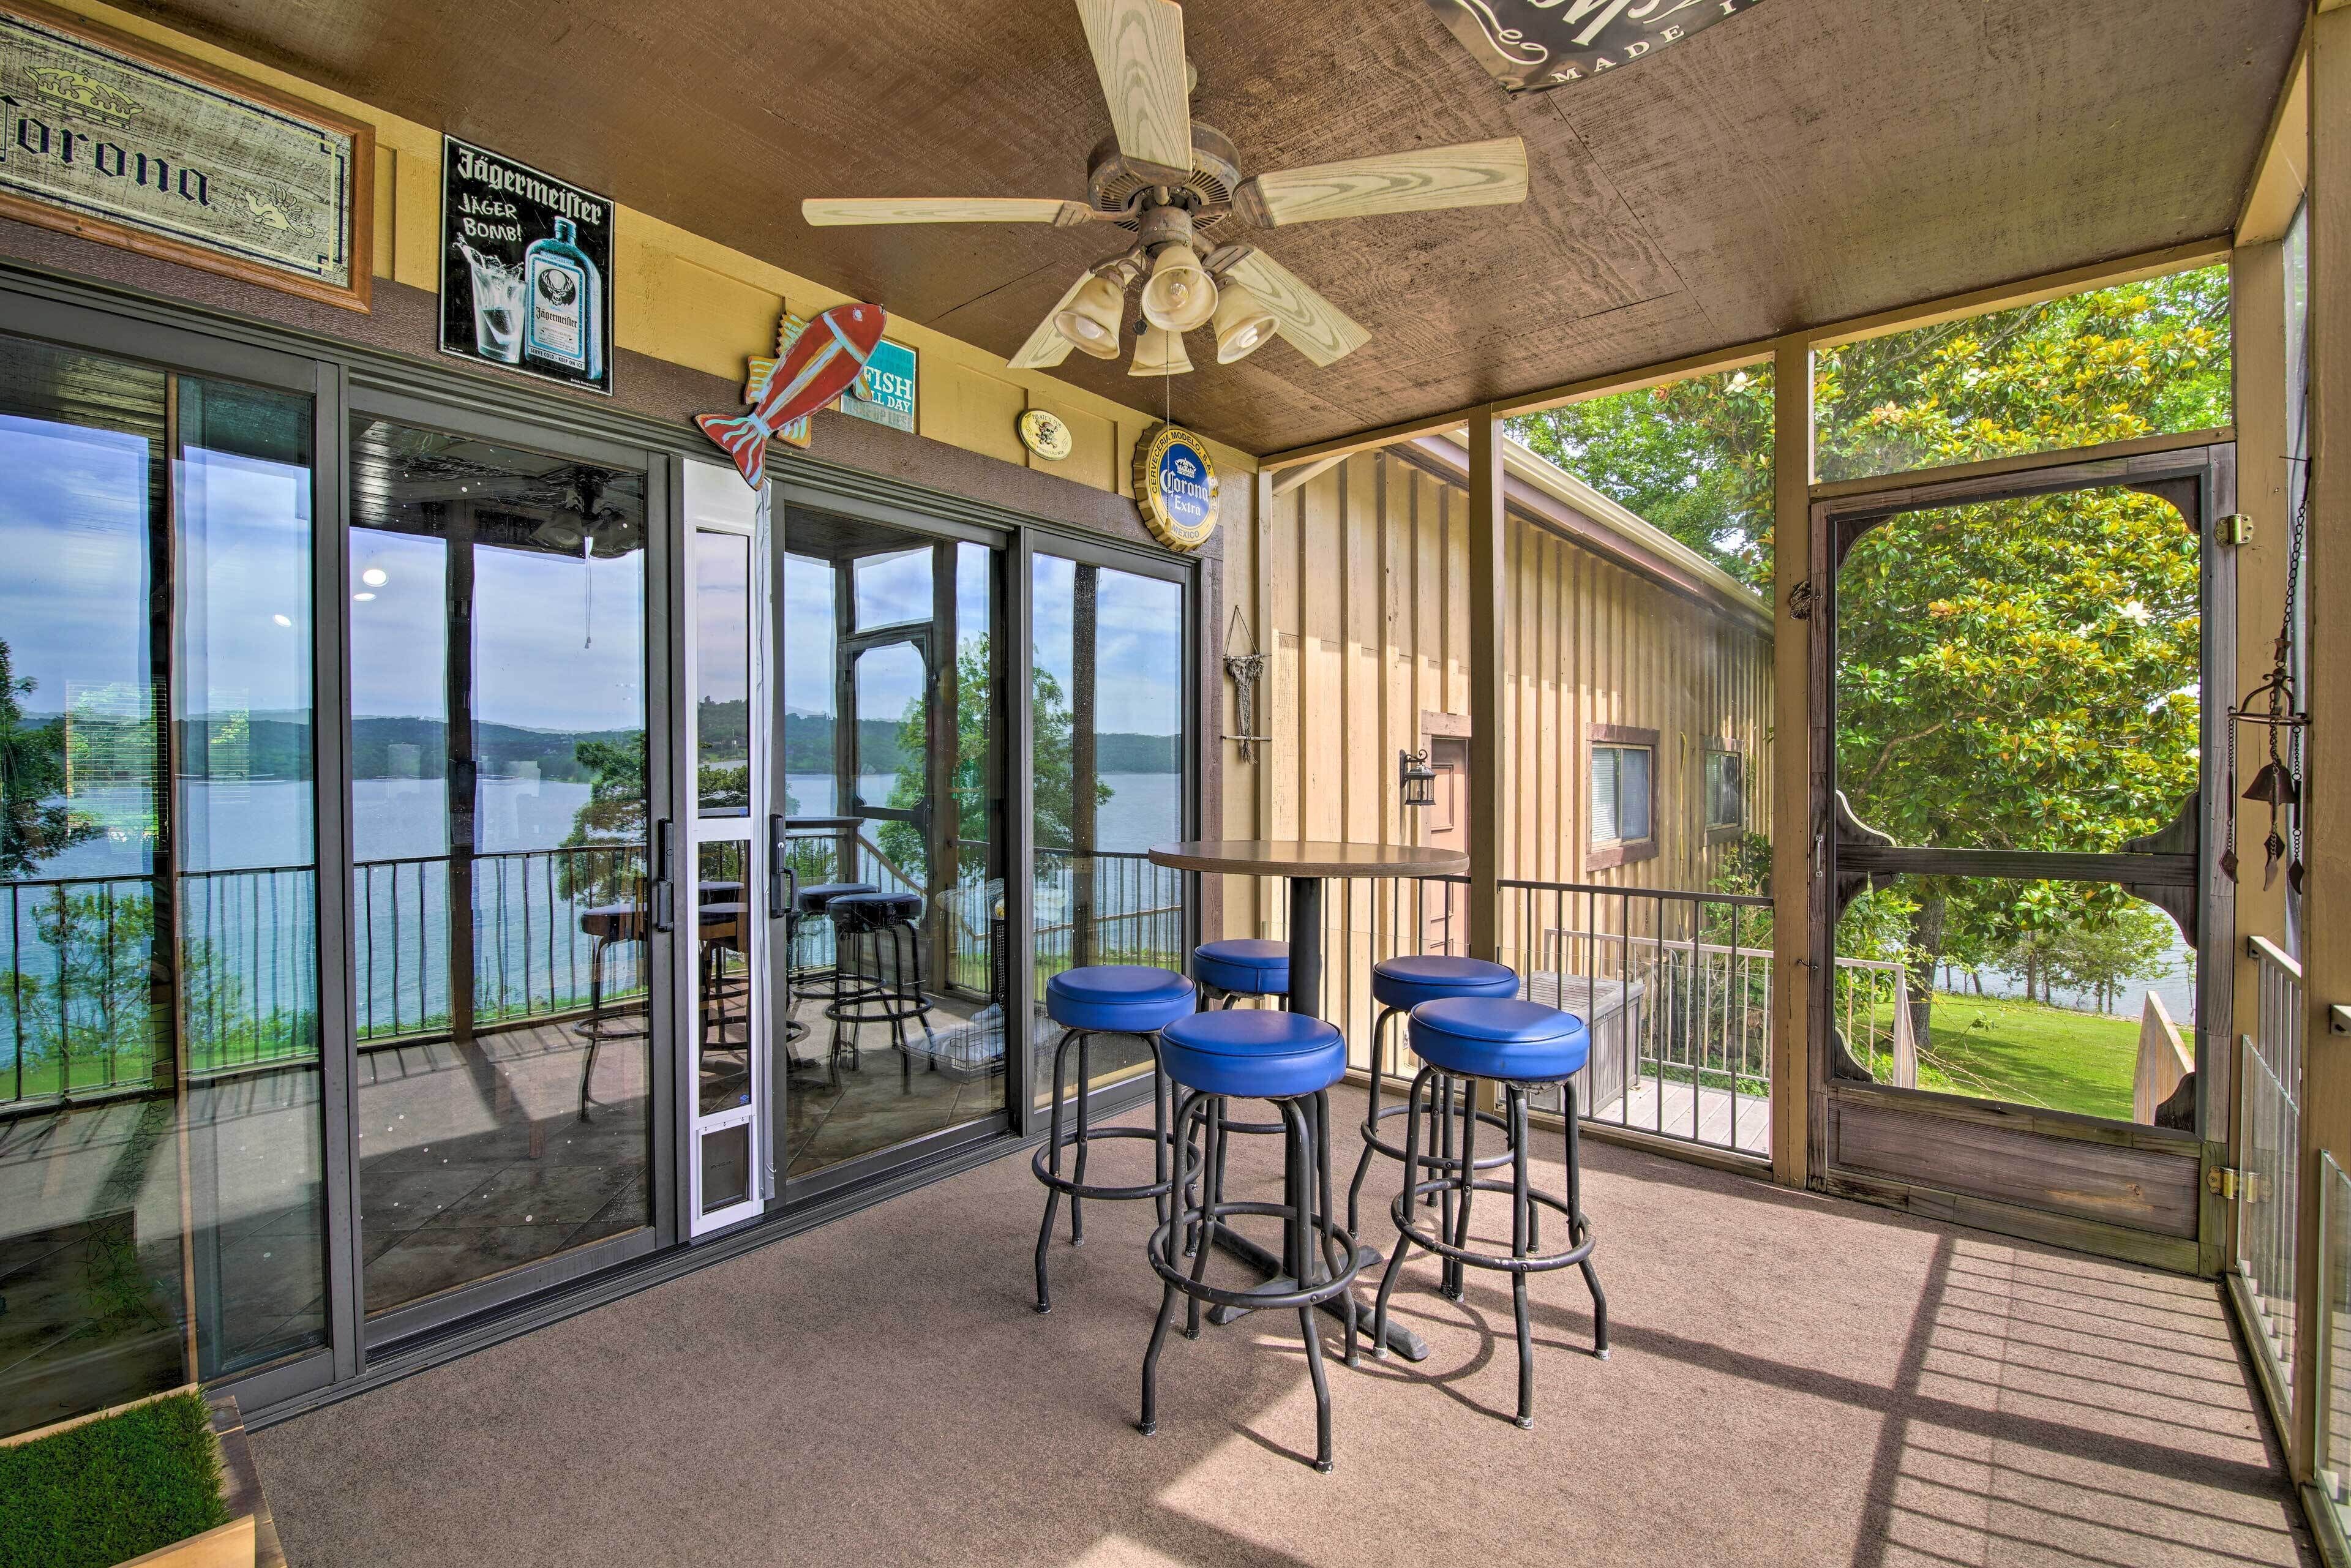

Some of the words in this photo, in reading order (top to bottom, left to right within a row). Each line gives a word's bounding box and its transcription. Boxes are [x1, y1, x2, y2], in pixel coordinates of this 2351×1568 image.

[1551, 24, 1685, 83] MADE
[463, 217, 522, 242] BOMB!
[863, 365, 912, 400] FISH
[871, 390, 885, 405] LL
[887, 396, 912, 413] DAY
[1150, 434, 1171, 494] CERVECERIA
[1171, 432, 1201, 454] MODELO,
[1160, 469, 1209, 503] Corona
[1174, 495, 1201, 516] Extra
[1171, 525, 1199, 539] MEXICO
